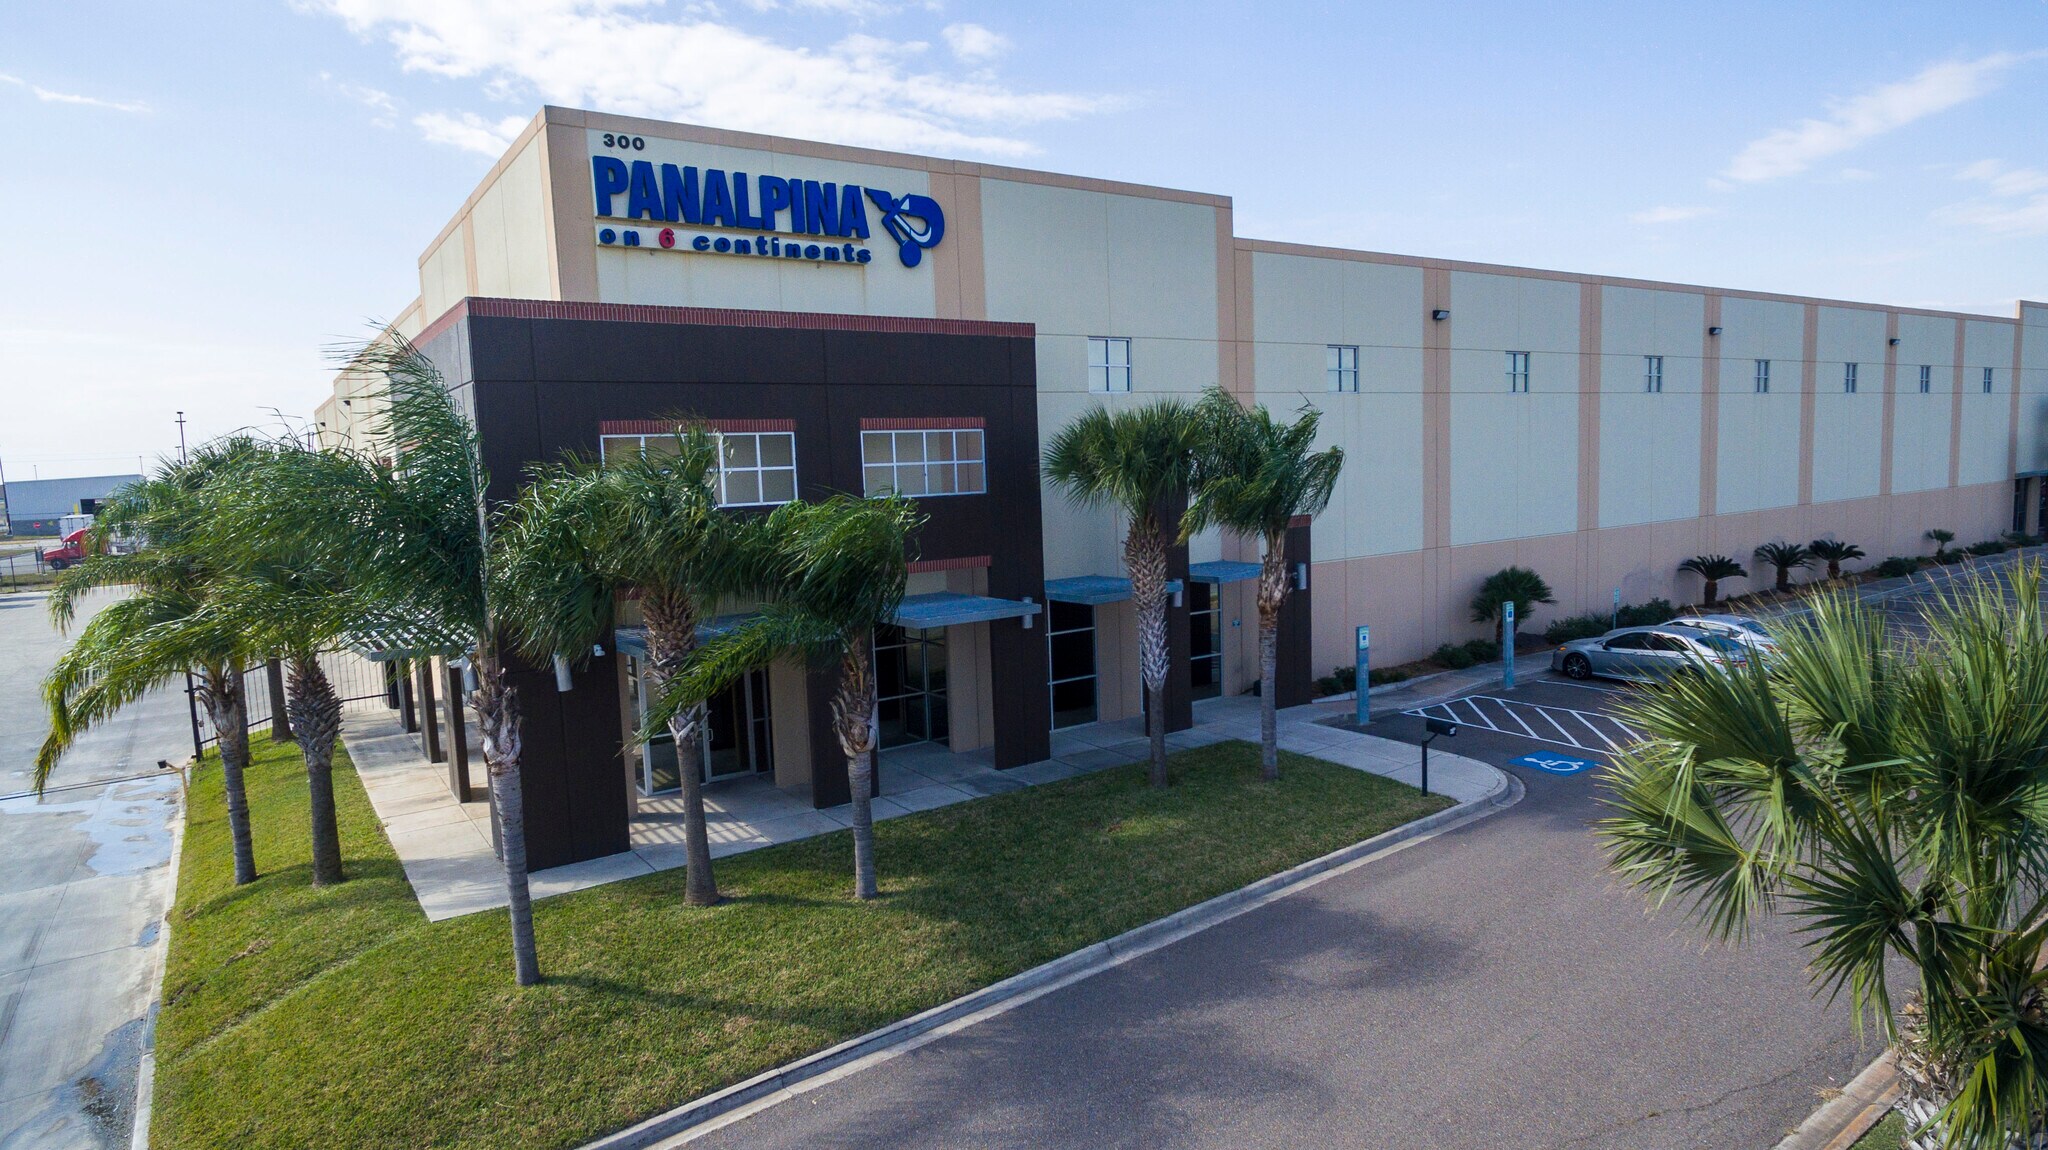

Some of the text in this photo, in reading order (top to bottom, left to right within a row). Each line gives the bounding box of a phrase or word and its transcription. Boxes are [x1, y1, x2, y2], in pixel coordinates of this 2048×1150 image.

[603, 133, 645, 151] 300
[592, 155, 870, 239] PANALPINA
[599, 227, 872, 263] on 6 continents
